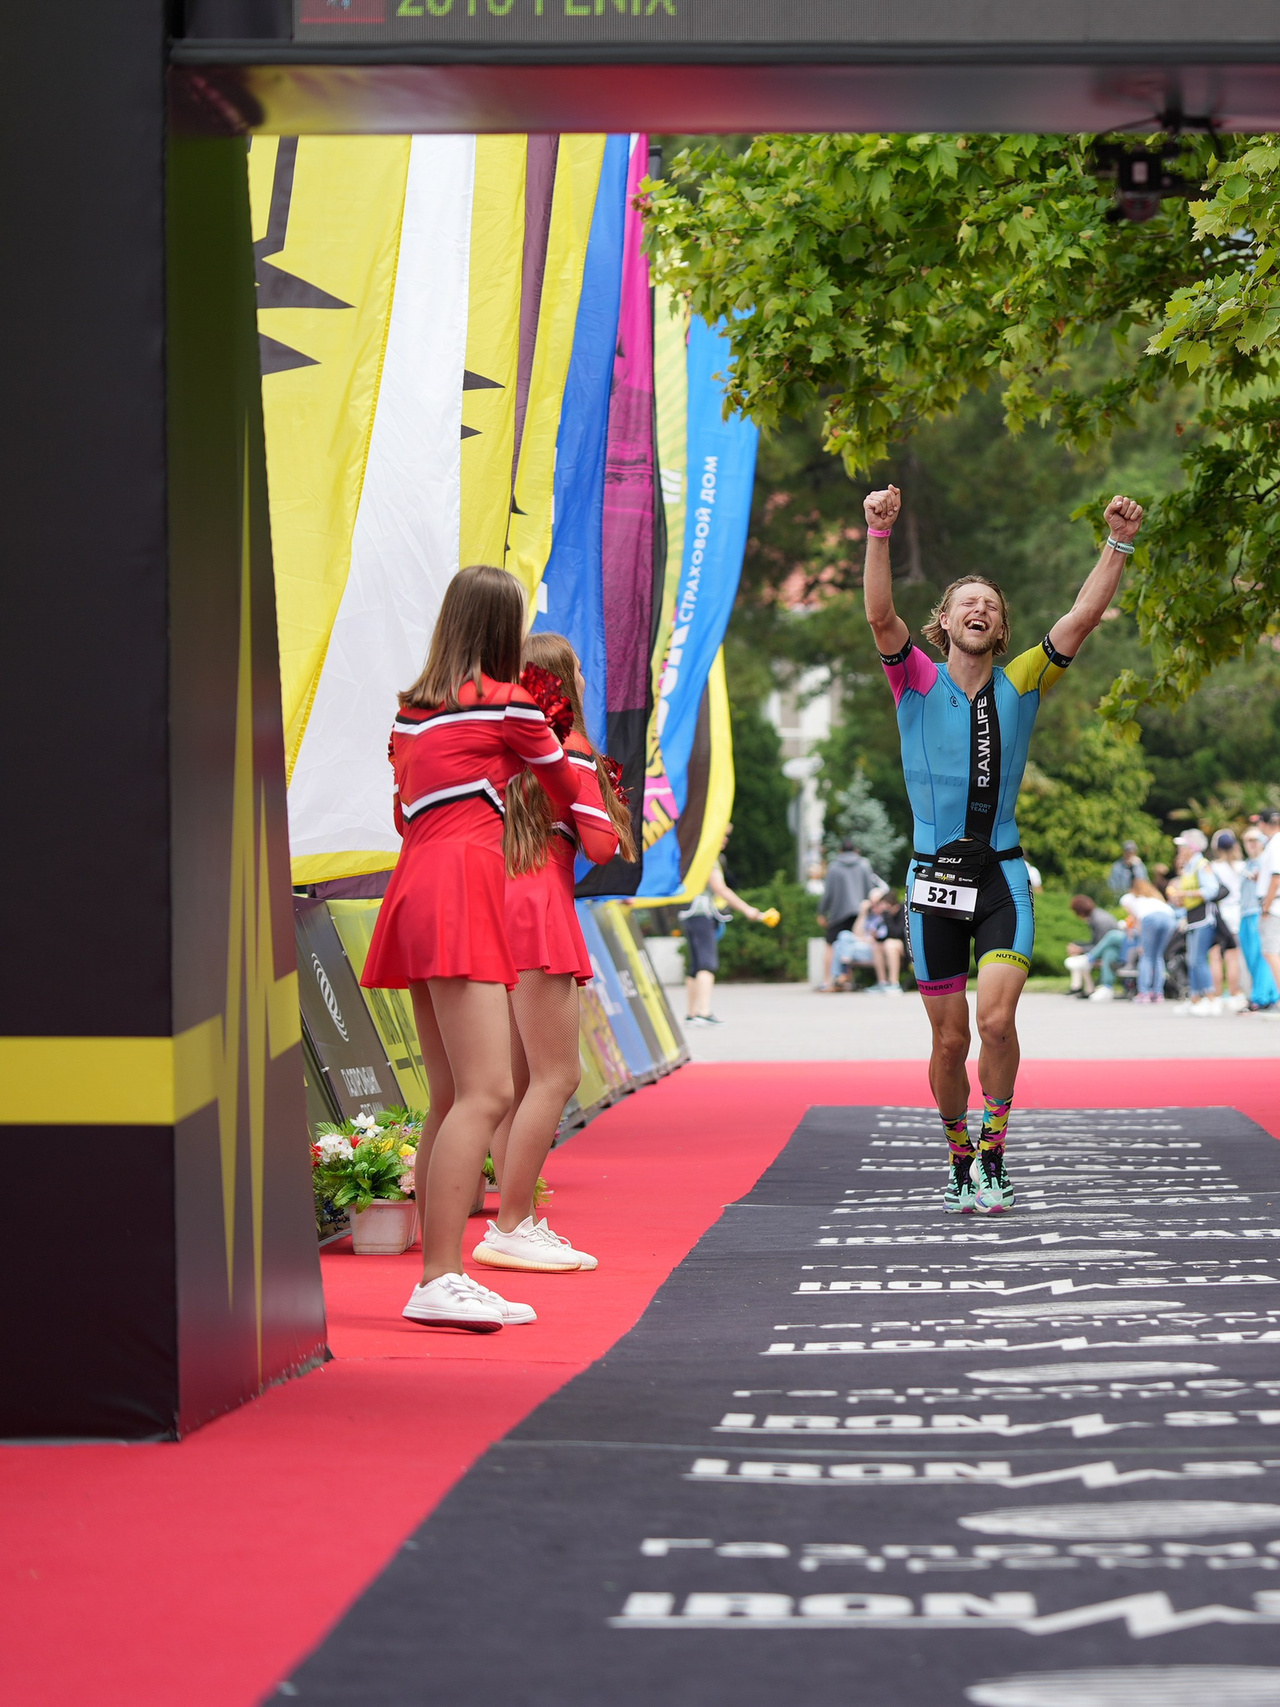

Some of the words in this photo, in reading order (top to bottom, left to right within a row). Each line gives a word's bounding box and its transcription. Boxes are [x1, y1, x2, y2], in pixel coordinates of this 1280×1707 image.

[678, 507, 712, 622] СТРАХОВОЙ
[700, 456, 718, 504] ДОМ
[927, 886, 957, 906] 521
[996, 953, 1017, 961] NUTS
[797, 1280, 1005, 1291] IRON
[768, 1339, 1008, 1352] IRON
[721, 1412, 1009, 1429] IRON
[691, 1458, 1011, 1478] IRON
[621, 1591, 1036, 1618] IRON
